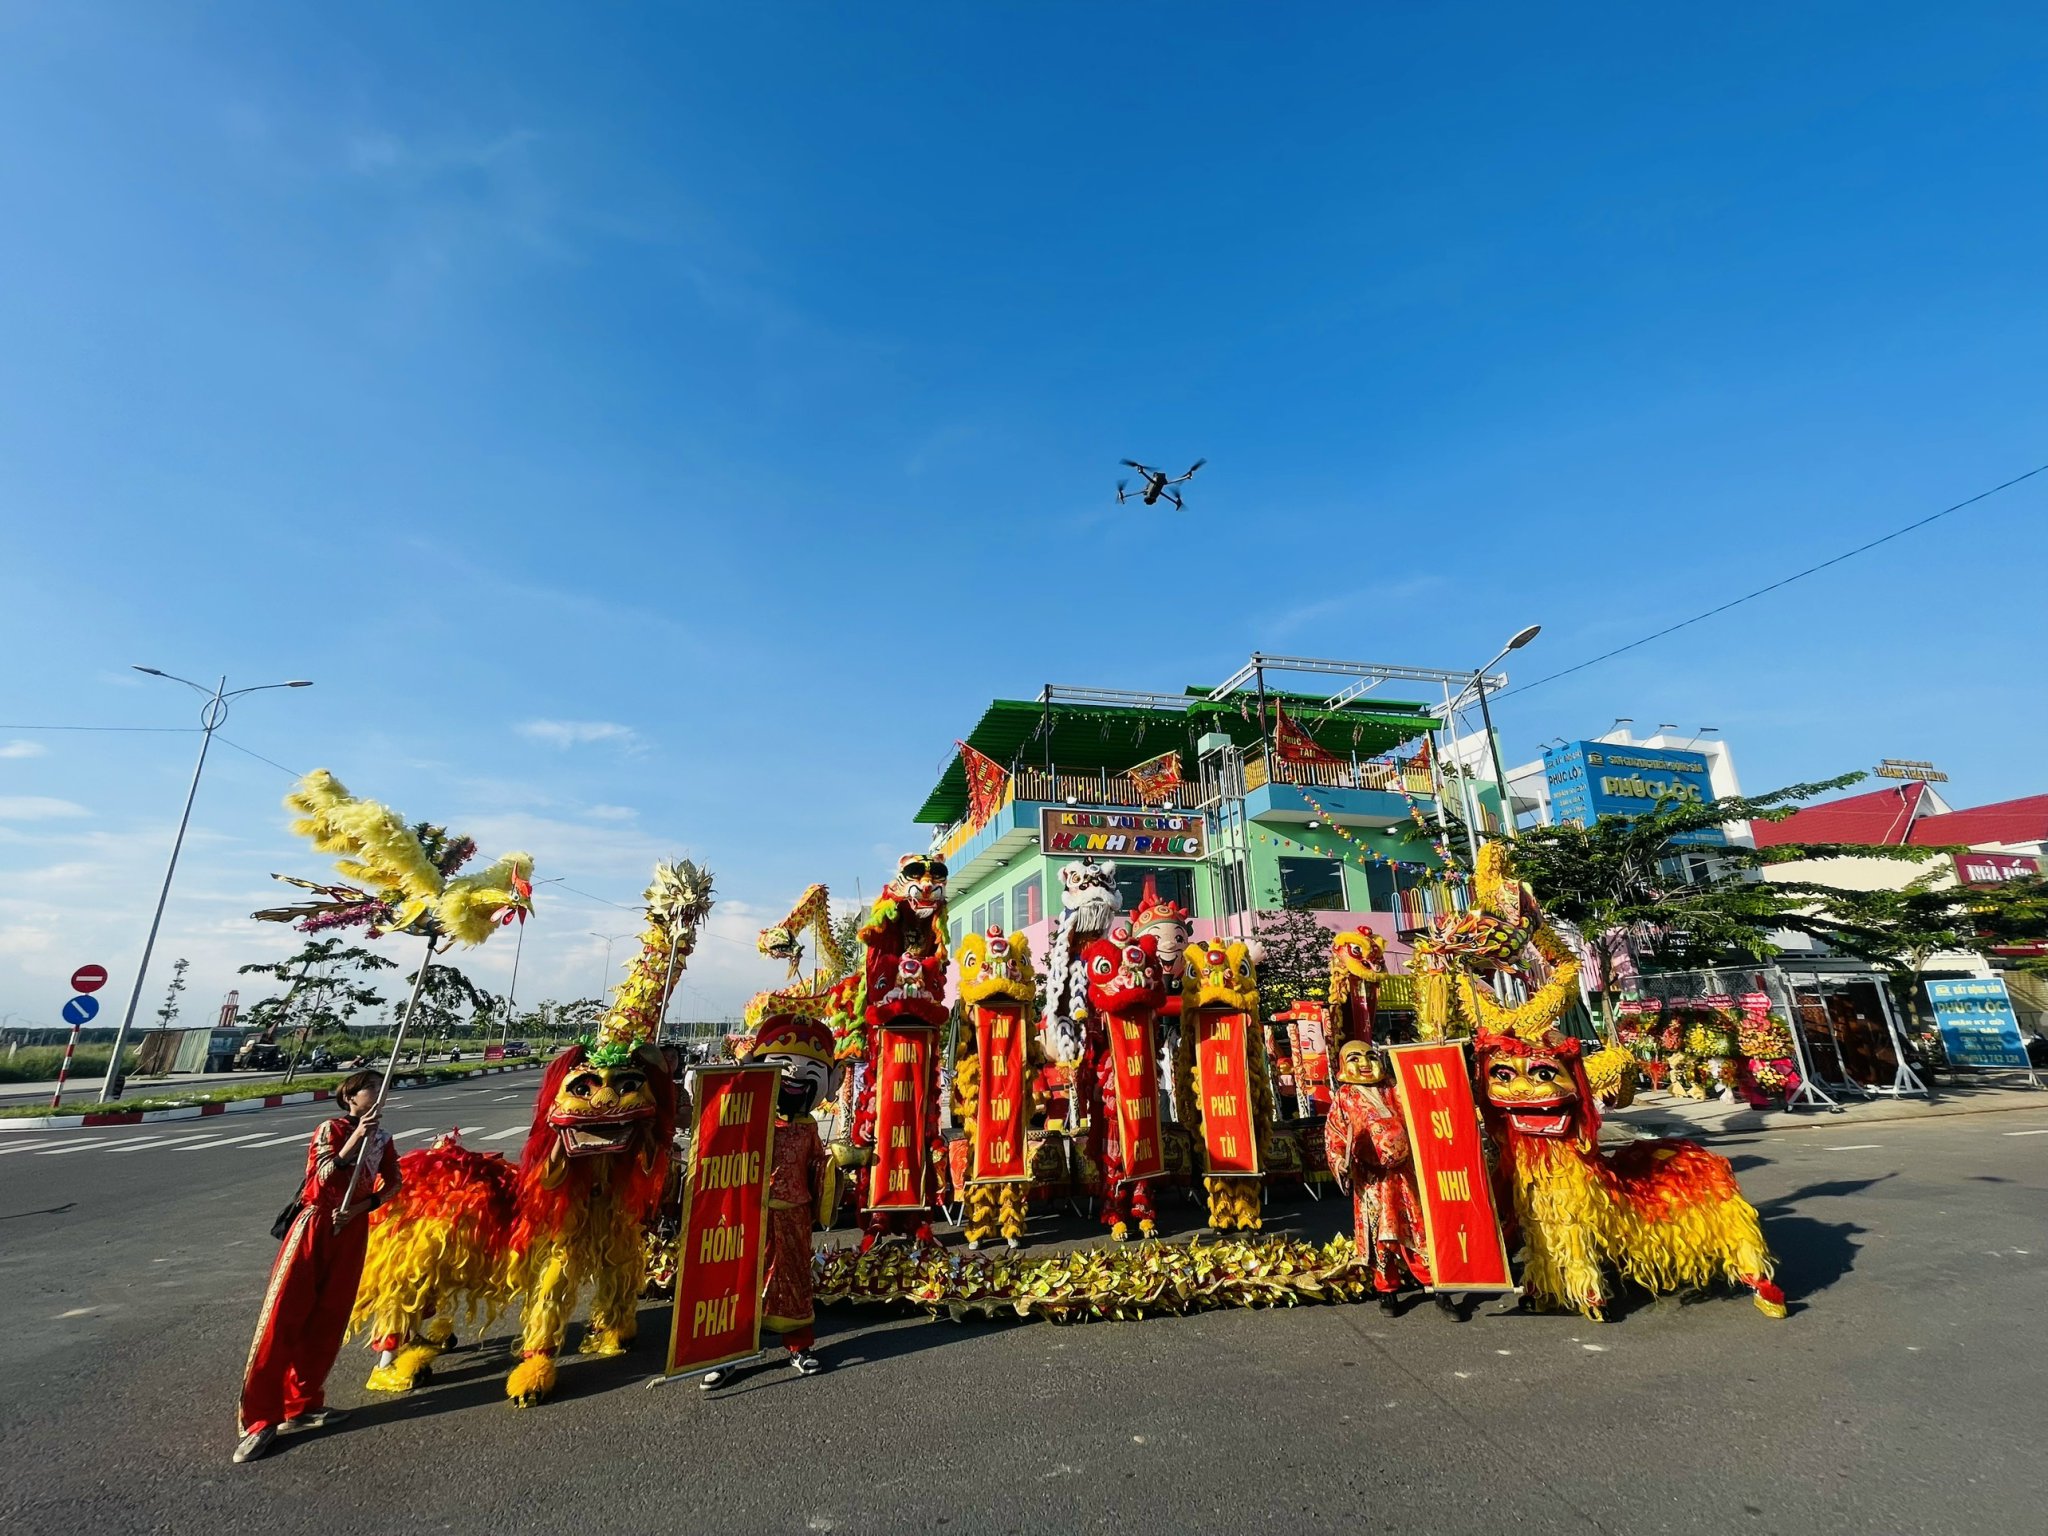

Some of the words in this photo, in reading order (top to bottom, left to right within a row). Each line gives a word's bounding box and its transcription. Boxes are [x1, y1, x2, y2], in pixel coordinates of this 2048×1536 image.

[1601, 773, 1664, 800] PHÚC
[1061, 813, 1102, 826] KHU
[1107, 815, 1139, 829] VUI
[1134, 834, 1199, 854] PHÚC
[1966, 860, 2003, 881] NHÀ
[1937, 999, 1973, 1014] PHÚC
[1976, 997, 2007, 1016] LỘC
[894, 1042, 918, 1064] MUA
[991, 1049, 1008, 1077] TÀI
[1215, 1051, 1229, 1075] ĂN
[893, 1080, 915, 1102] MAY
[1413, 1062, 1448, 1096] VẠN
[719, 1092, 755, 1127] KHAI
[990, 1091, 1011, 1121] TẤN
[1210, 1090, 1237, 1117] PHÁT
[891, 1120, 912, 1148] BÁN
[1430, 1106, 1454, 1146] SỰ
[990, 1136, 1011, 1169] LỘC
[1219, 1130, 1237, 1158] TÀI
[888, 1160, 910, 1192] ĐẤT
[1436, 1166, 1471, 1202] NHƯ
[699, 1213, 745, 1265] HỒNG
[1457, 1223, 1469, 1264] Ý
[692, 1287, 740, 1339] PHÁT
